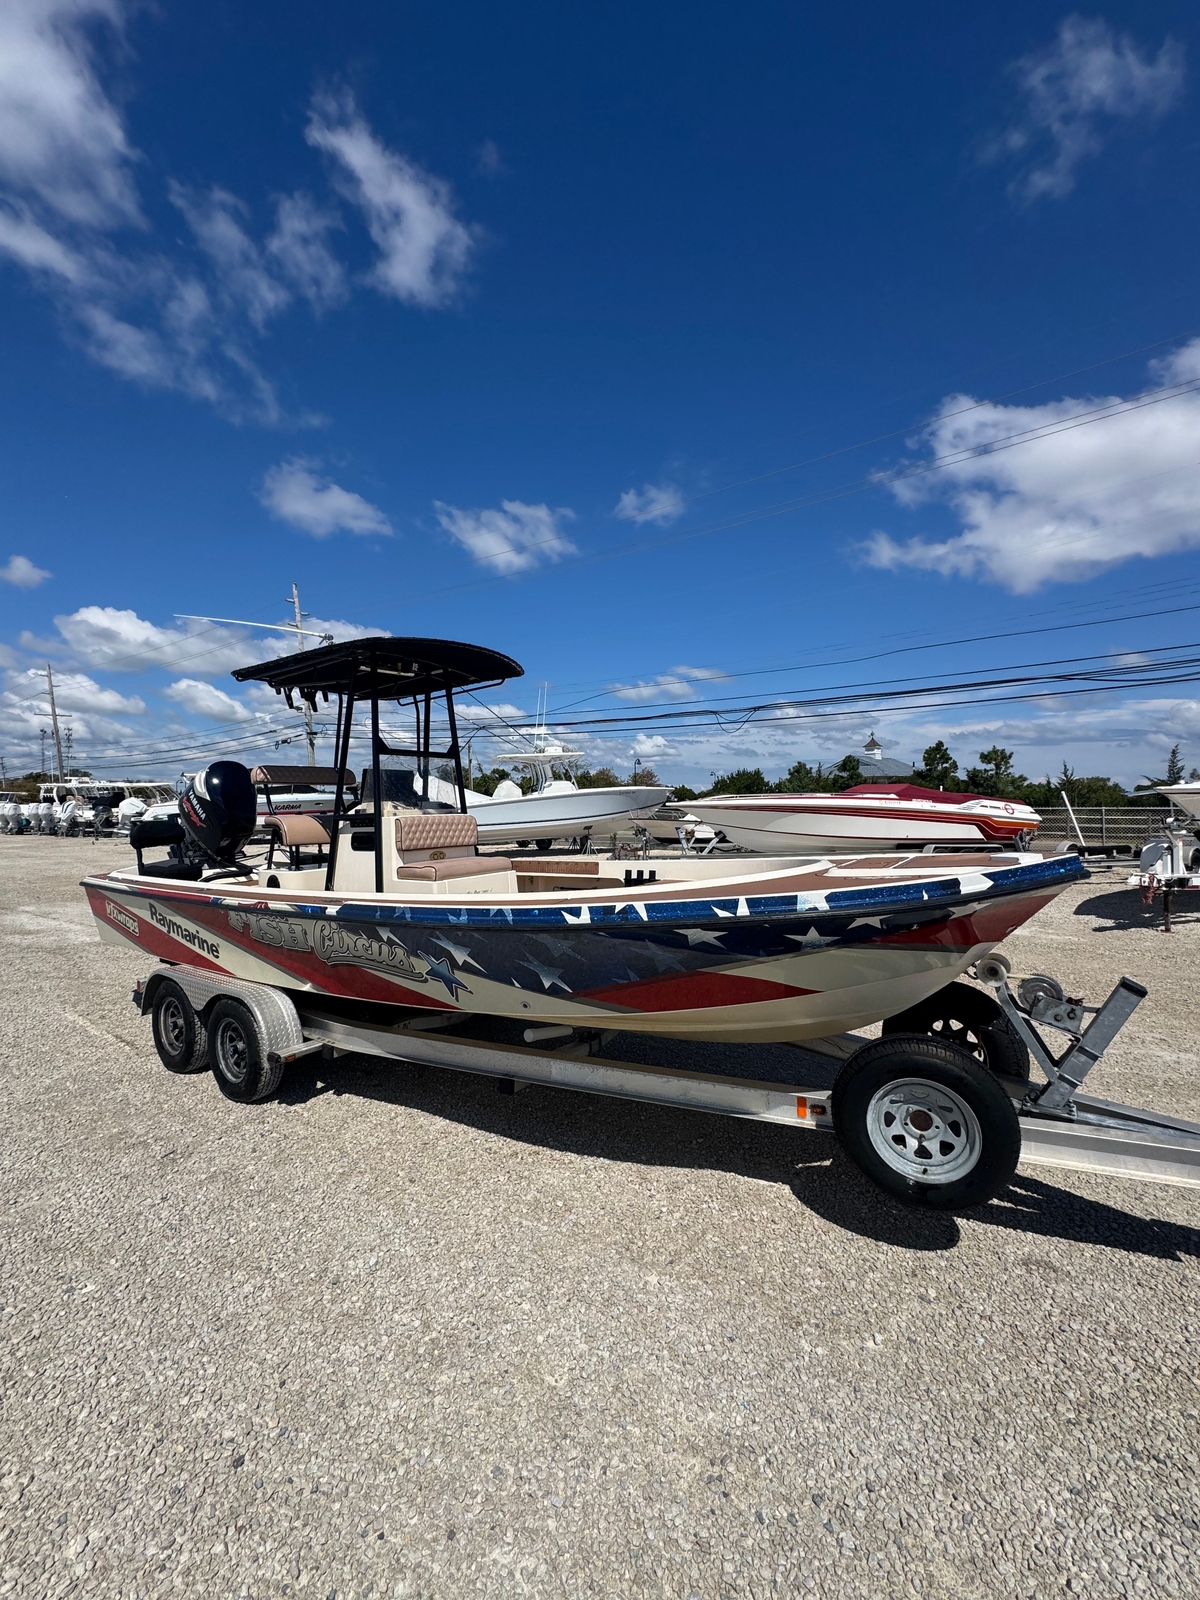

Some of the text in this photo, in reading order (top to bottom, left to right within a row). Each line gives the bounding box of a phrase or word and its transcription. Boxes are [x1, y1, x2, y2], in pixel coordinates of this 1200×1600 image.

[188, 789, 207, 821] YAMAHA
[273, 803, 302, 811] KARMA
[148, 902, 220, 959] Raymarine
[228, 910, 423, 979] FISH Circus
